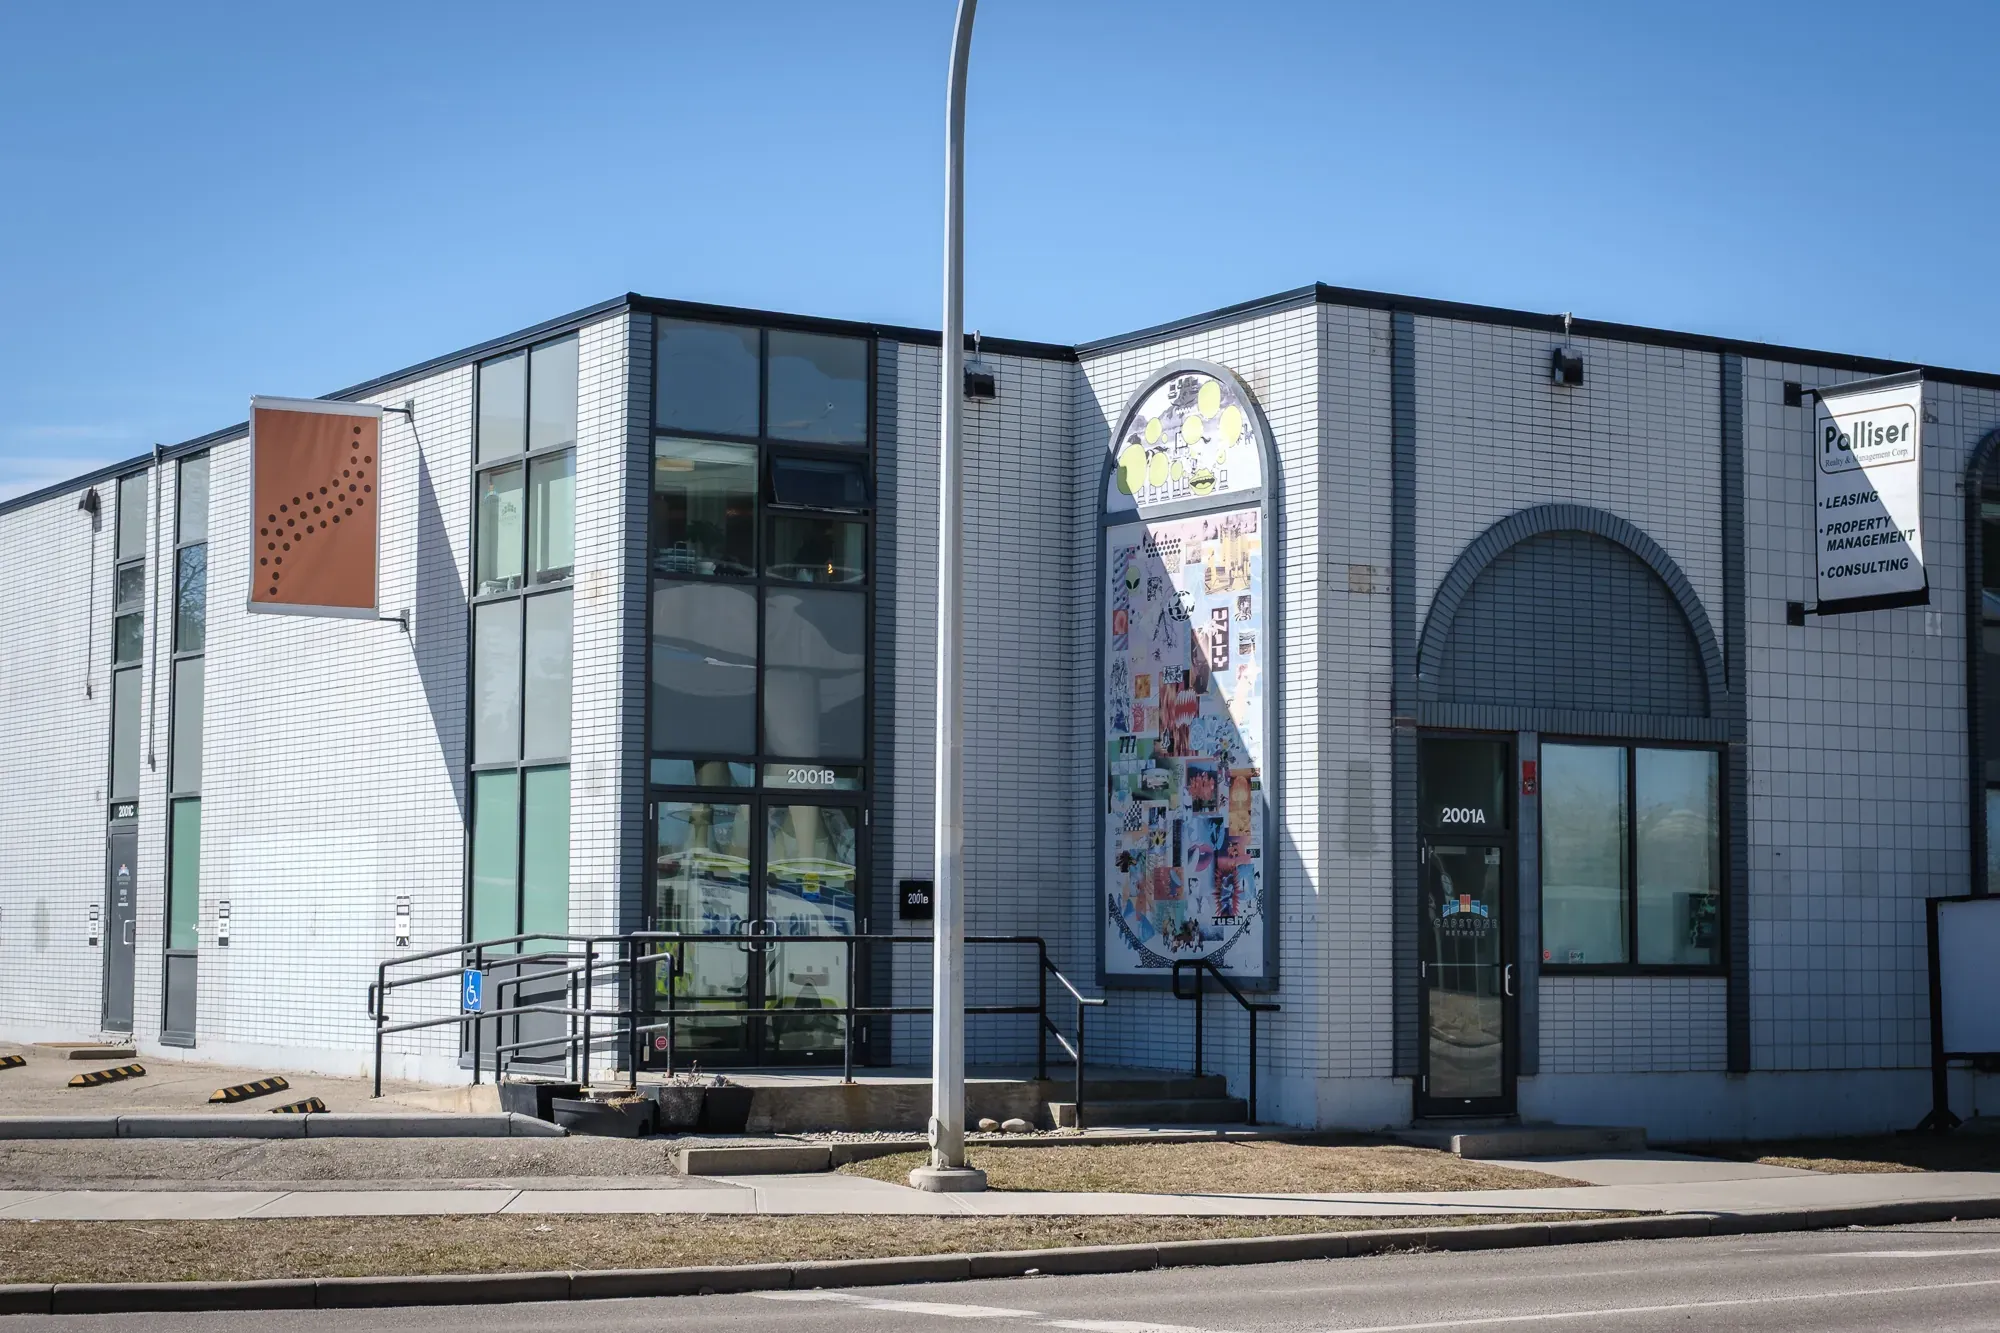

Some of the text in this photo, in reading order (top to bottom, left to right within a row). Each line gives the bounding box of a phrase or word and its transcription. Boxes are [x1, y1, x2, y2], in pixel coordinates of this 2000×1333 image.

[1826, 421, 1909, 453] Palliser
[1825, 457, 1843, 467] Realty
[1853, 452, 1890, 462] Management
[1826, 490, 1878, 509] LEASING
[1826, 515, 1891, 536] PROPERTY
[1826, 529, 1915, 552] MANAGEMENT
[1827, 557, 1909, 578] CONSULTING
[1212, 609, 1228, 667] UNITY
[1119, 735, 1136, 753] 777
[787, 769, 835, 784] 2001B
[118, 805, 134, 817] 2001C
[1442, 807, 1485, 823] 2001A
[1211, 915, 1243, 925] rush
[1433, 918, 1497, 928] CAPSTONE
